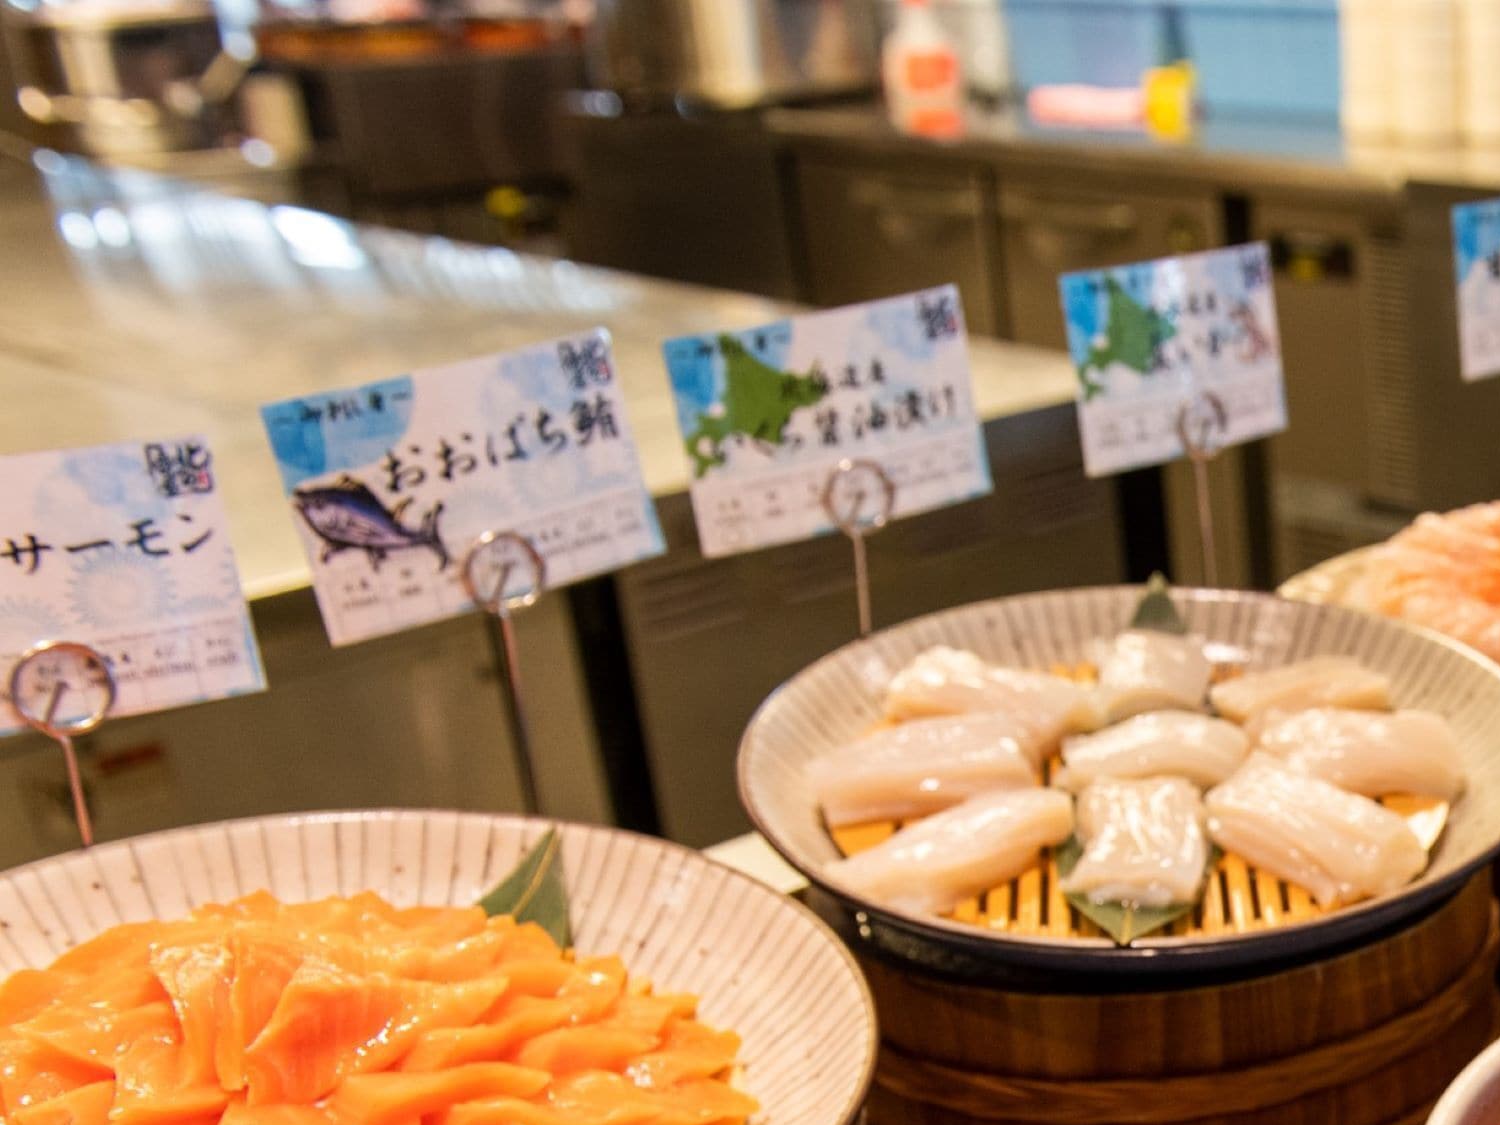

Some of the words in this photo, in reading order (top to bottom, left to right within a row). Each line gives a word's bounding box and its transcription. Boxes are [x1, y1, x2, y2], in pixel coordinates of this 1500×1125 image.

[384, 395, 620, 493] おおばち鮪
[0, 513, 215, 576] サーモン
